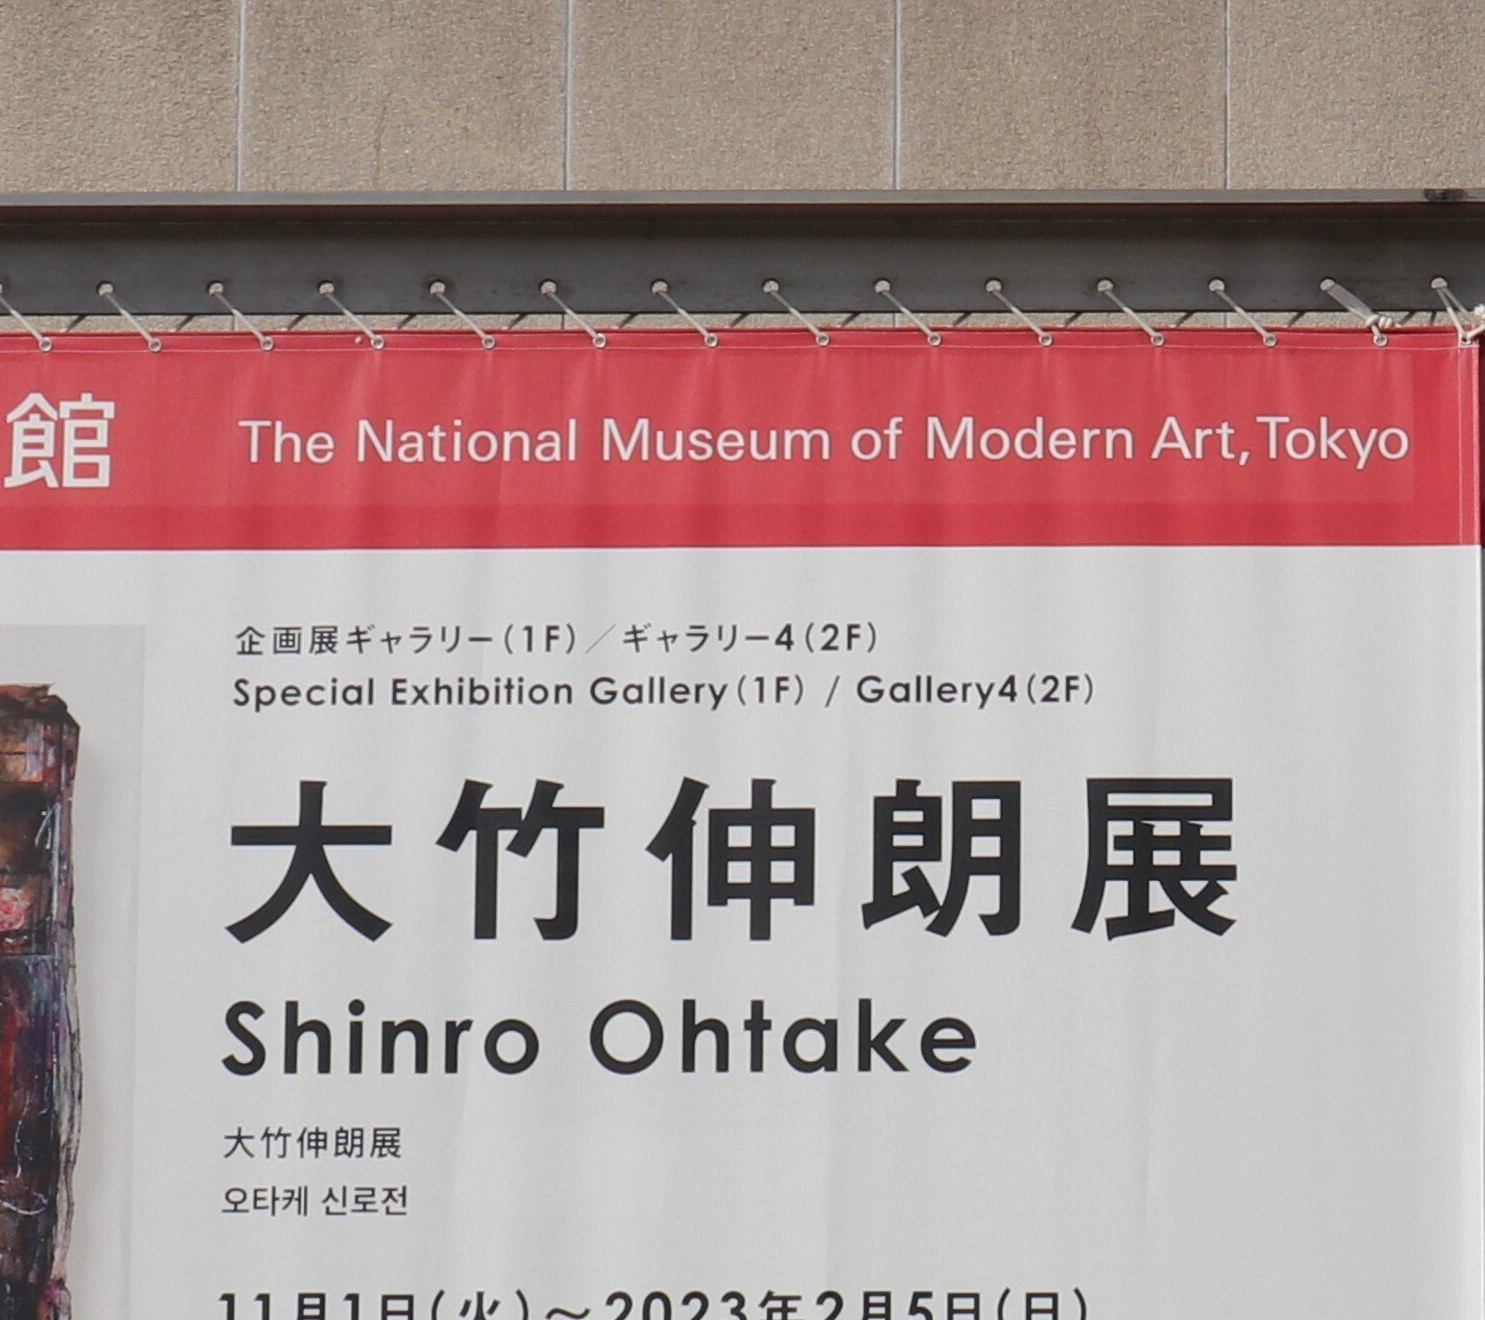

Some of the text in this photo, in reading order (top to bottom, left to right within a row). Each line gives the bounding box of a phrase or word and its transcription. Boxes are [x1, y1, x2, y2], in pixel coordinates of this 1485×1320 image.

[238, 420, 335, 464] The
[357, 418, 577, 463] National
[602, 418, 830, 461] Museum
[851, 416, 904, 460] of
[927, 416, 1133, 460] Modern
[233, 677, 374, 713] Special
[391, 676, 573, 706] Exhibition
[224, 776, 1238, 945] 大竹伸朗展
[221, 997, 977, 1077] Shinro Ohtake
[223, 1126, 401, 1159] 大竹伸朗展
[221, 1184, 407, 1217] 오타케 신로전
